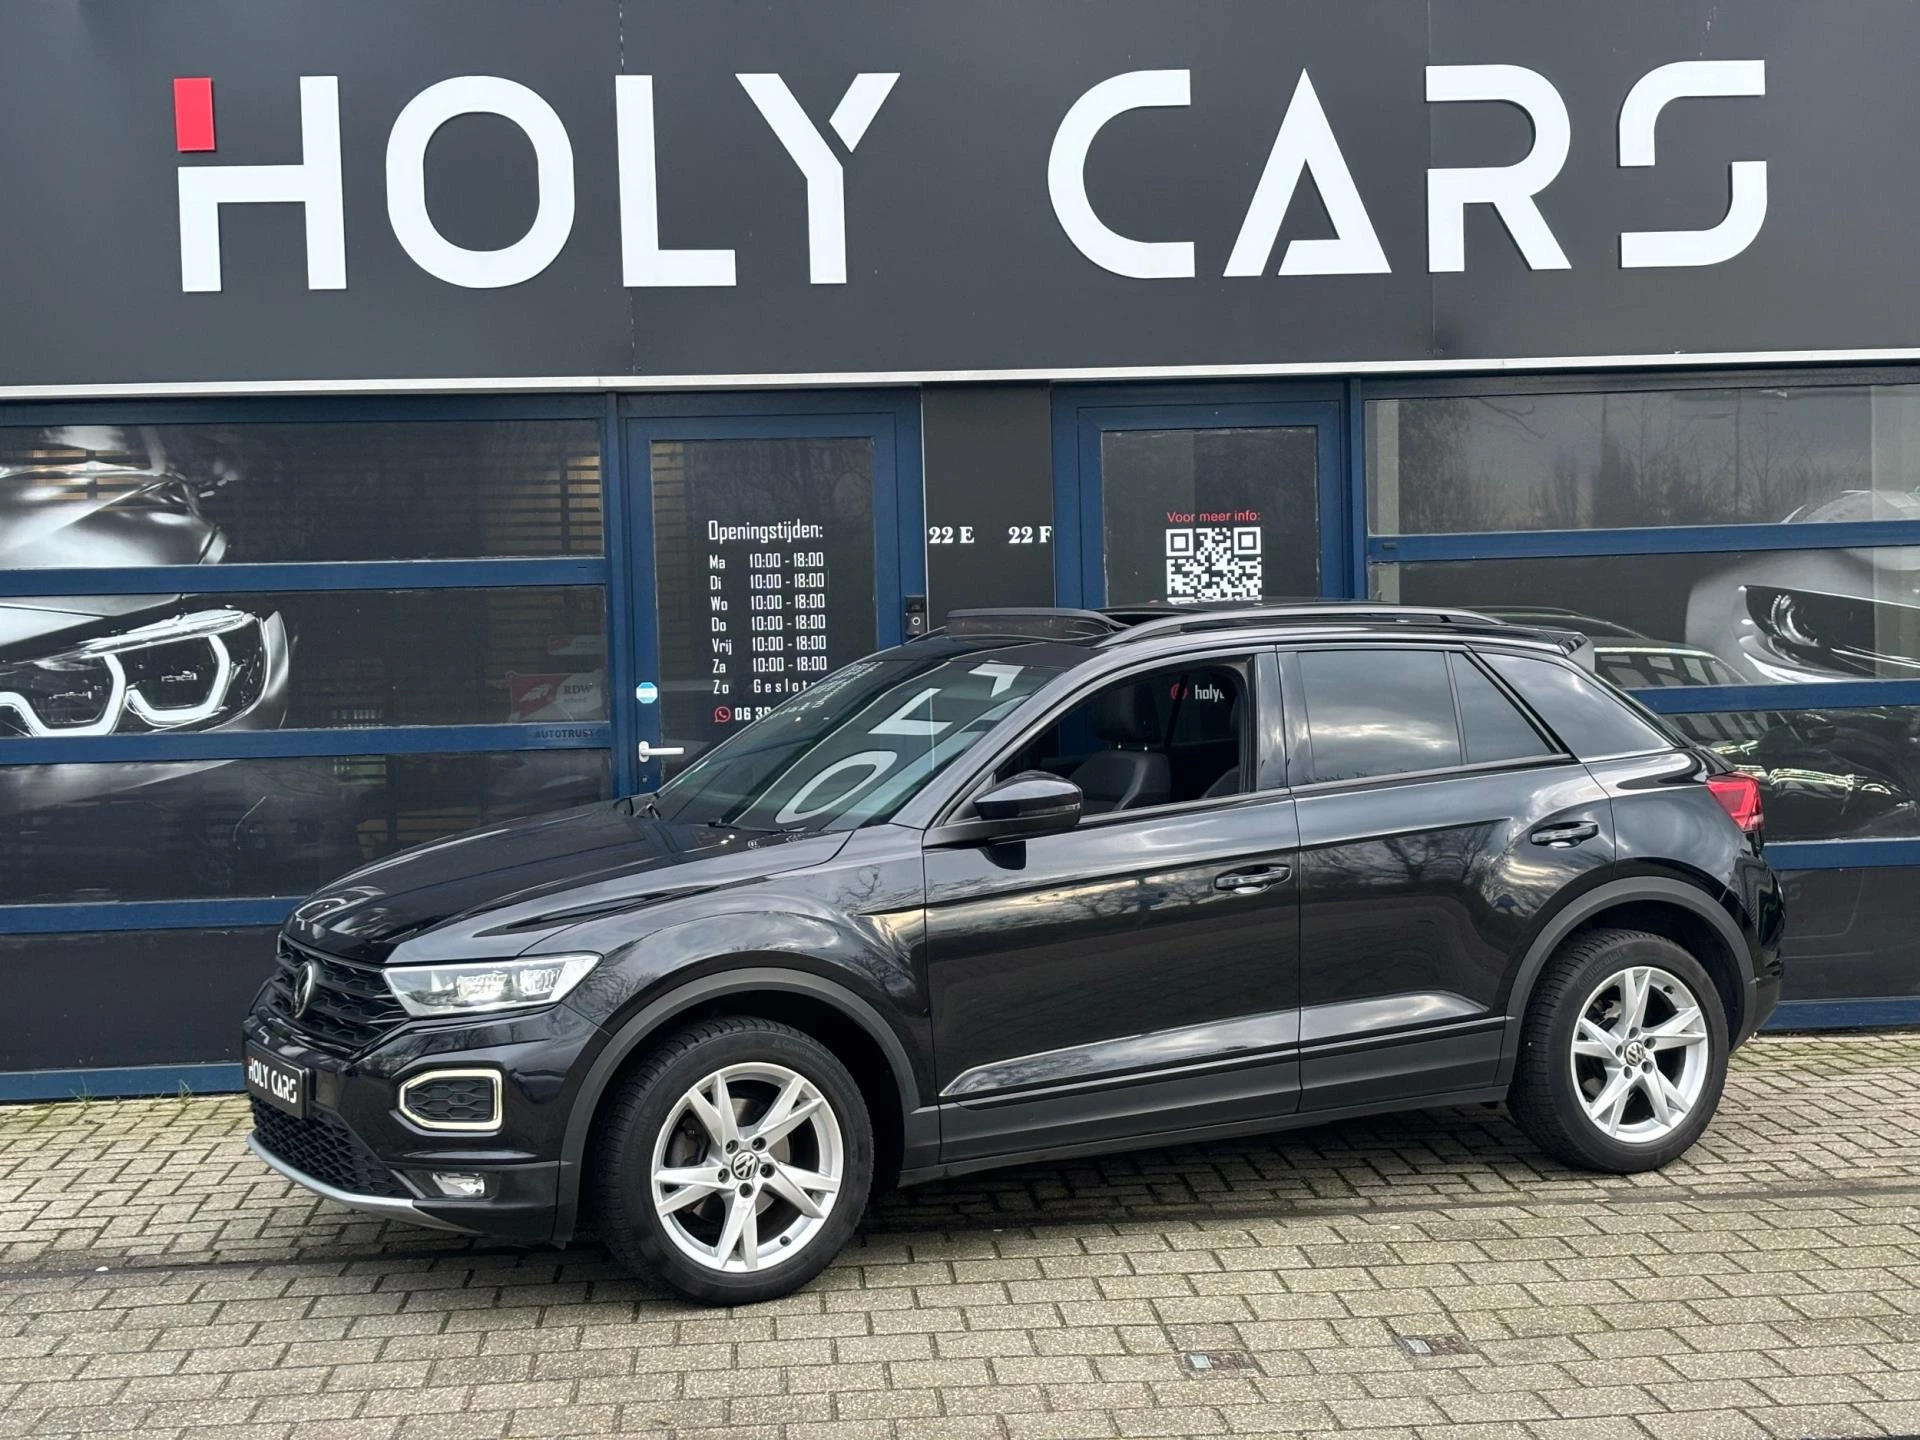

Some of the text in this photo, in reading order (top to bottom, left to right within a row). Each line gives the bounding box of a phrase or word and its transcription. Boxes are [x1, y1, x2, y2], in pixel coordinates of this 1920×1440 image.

[173, 59, 1767, 292] HOLY CARS
[1166, 510, 1261, 523] Voor meer info:
[708, 518, 823, 544] Openingstijden:
[928, 526, 975, 544] 22 E
[1008, 525, 1052, 544] 22 F
[709, 554, 726, 569] Ma
[750, 553, 781, 568] 10:00
[793, 552, 824, 567] 18:00
[710, 575, 722, 590] Di
[750, 574, 782, 589] 10:00
[794, 573, 825, 588] 18:00
[710, 596, 728, 611] Wo
[751, 595, 782, 610] 10:00
[795, 593, 825, 609] 18:00
[711, 617, 727, 632] Do
[752, 616, 783, 631] 10:00
[795, 615, 826, 630] 18:00
[712, 638, 732, 655] Vrij
[752, 637, 784, 652] 10:00
[796, 635, 826, 651] 18:00
[712, 659, 727, 674] Za
[753, 657, 784, 673] 10:00
[797, 656, 827, 671] 18:00
[713, 678, 816, 695] Zo Geslot
[735, 707, 751, 721] 06
[248, 1056, 297, 1104] HOLY CARS
